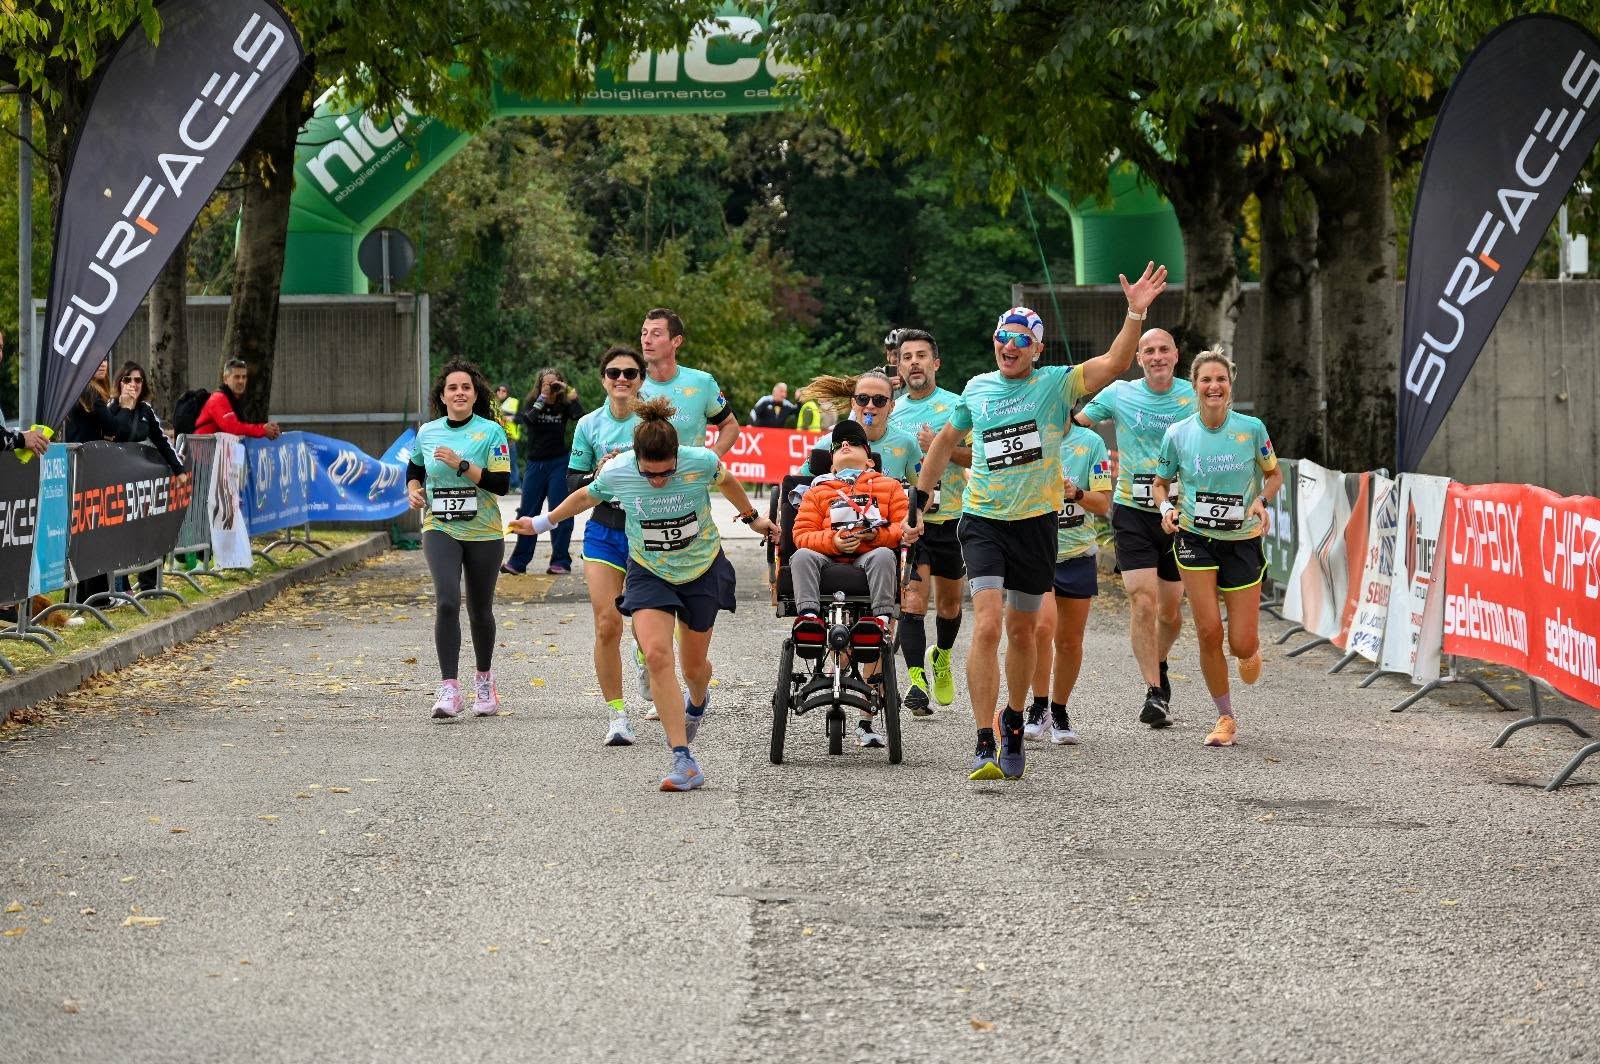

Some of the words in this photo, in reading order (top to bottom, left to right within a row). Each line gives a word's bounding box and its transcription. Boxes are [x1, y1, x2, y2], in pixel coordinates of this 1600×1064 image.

[53, 12, 285, 366] SURFACES
[1405, 49, 1600, 404] SURFACES
[1001, 437, 1024, 454] 36
[442, 498, 466, 511] 137
[1209, 505, 1230, 518] 67
[661, 528, 682, 541] 19
[1452, 497, 1524, 578] CHIPBOX
[1540, 505, 1600, 600] CHIPB
[1444, 583, 1529, 657] seletron.com
